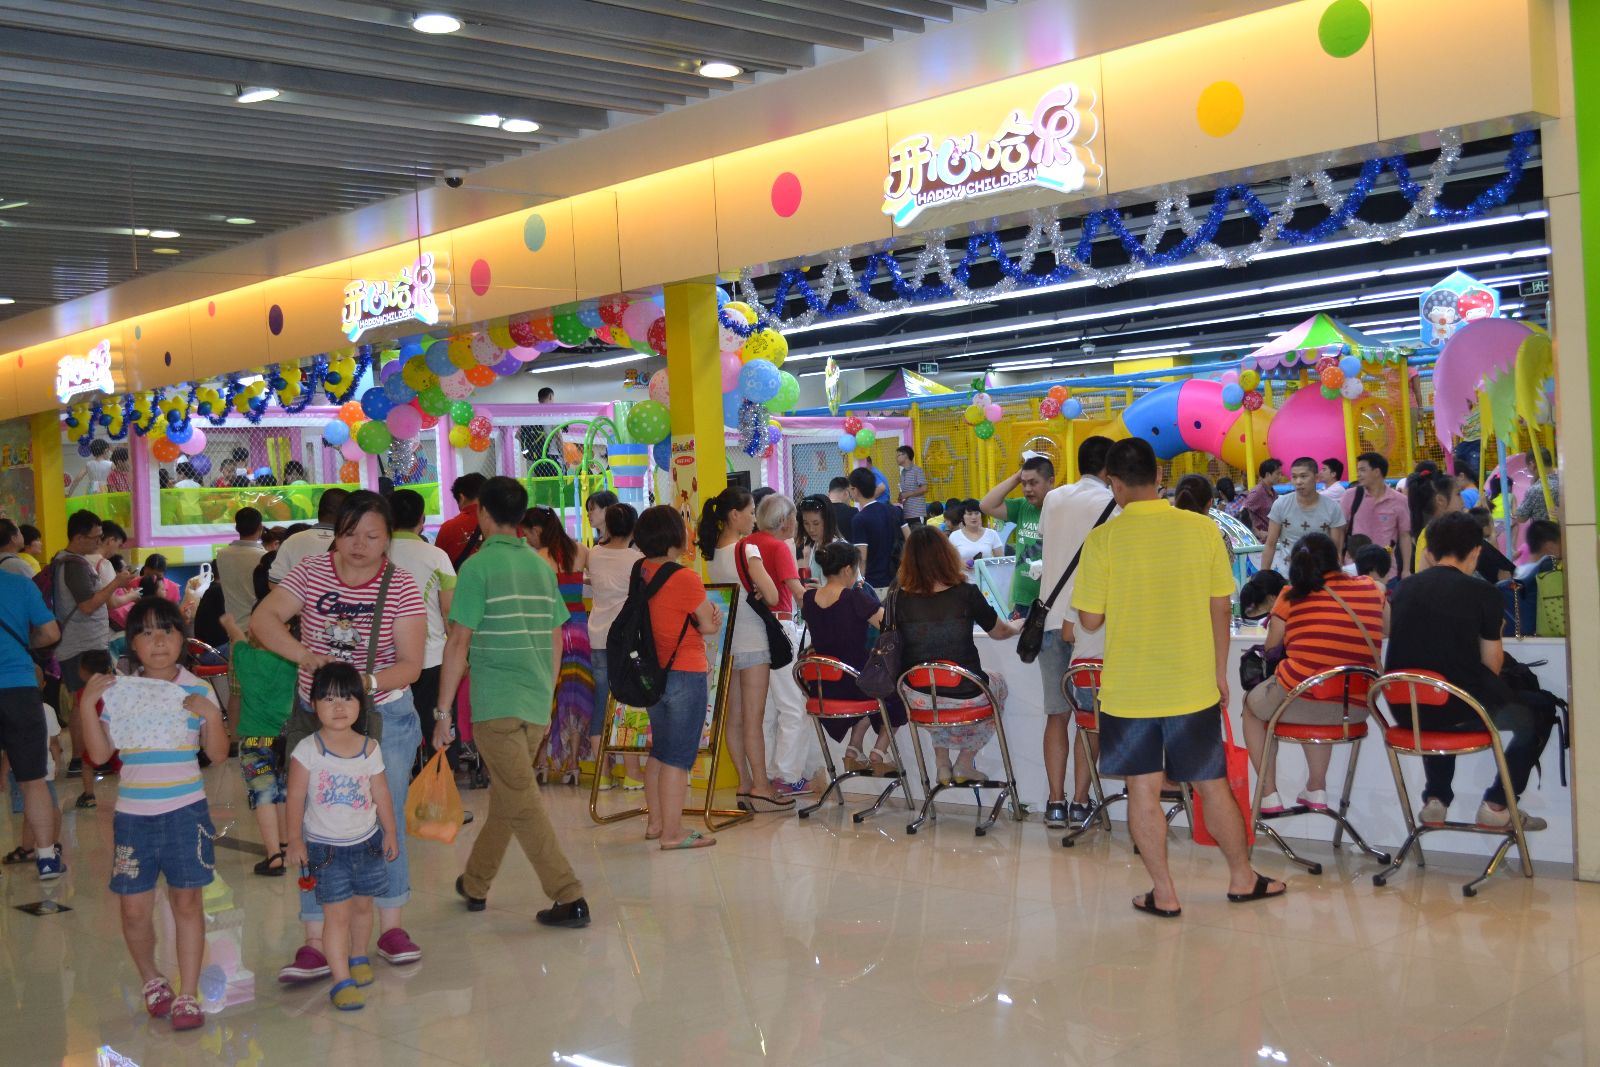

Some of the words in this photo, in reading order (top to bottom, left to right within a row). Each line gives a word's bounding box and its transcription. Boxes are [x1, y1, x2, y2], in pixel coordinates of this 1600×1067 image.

[917, 187, 962, 206] HAPPY
[967, 169, 1037, 195] CHILDREN
[1022, 522, 1040, 531] VAN
